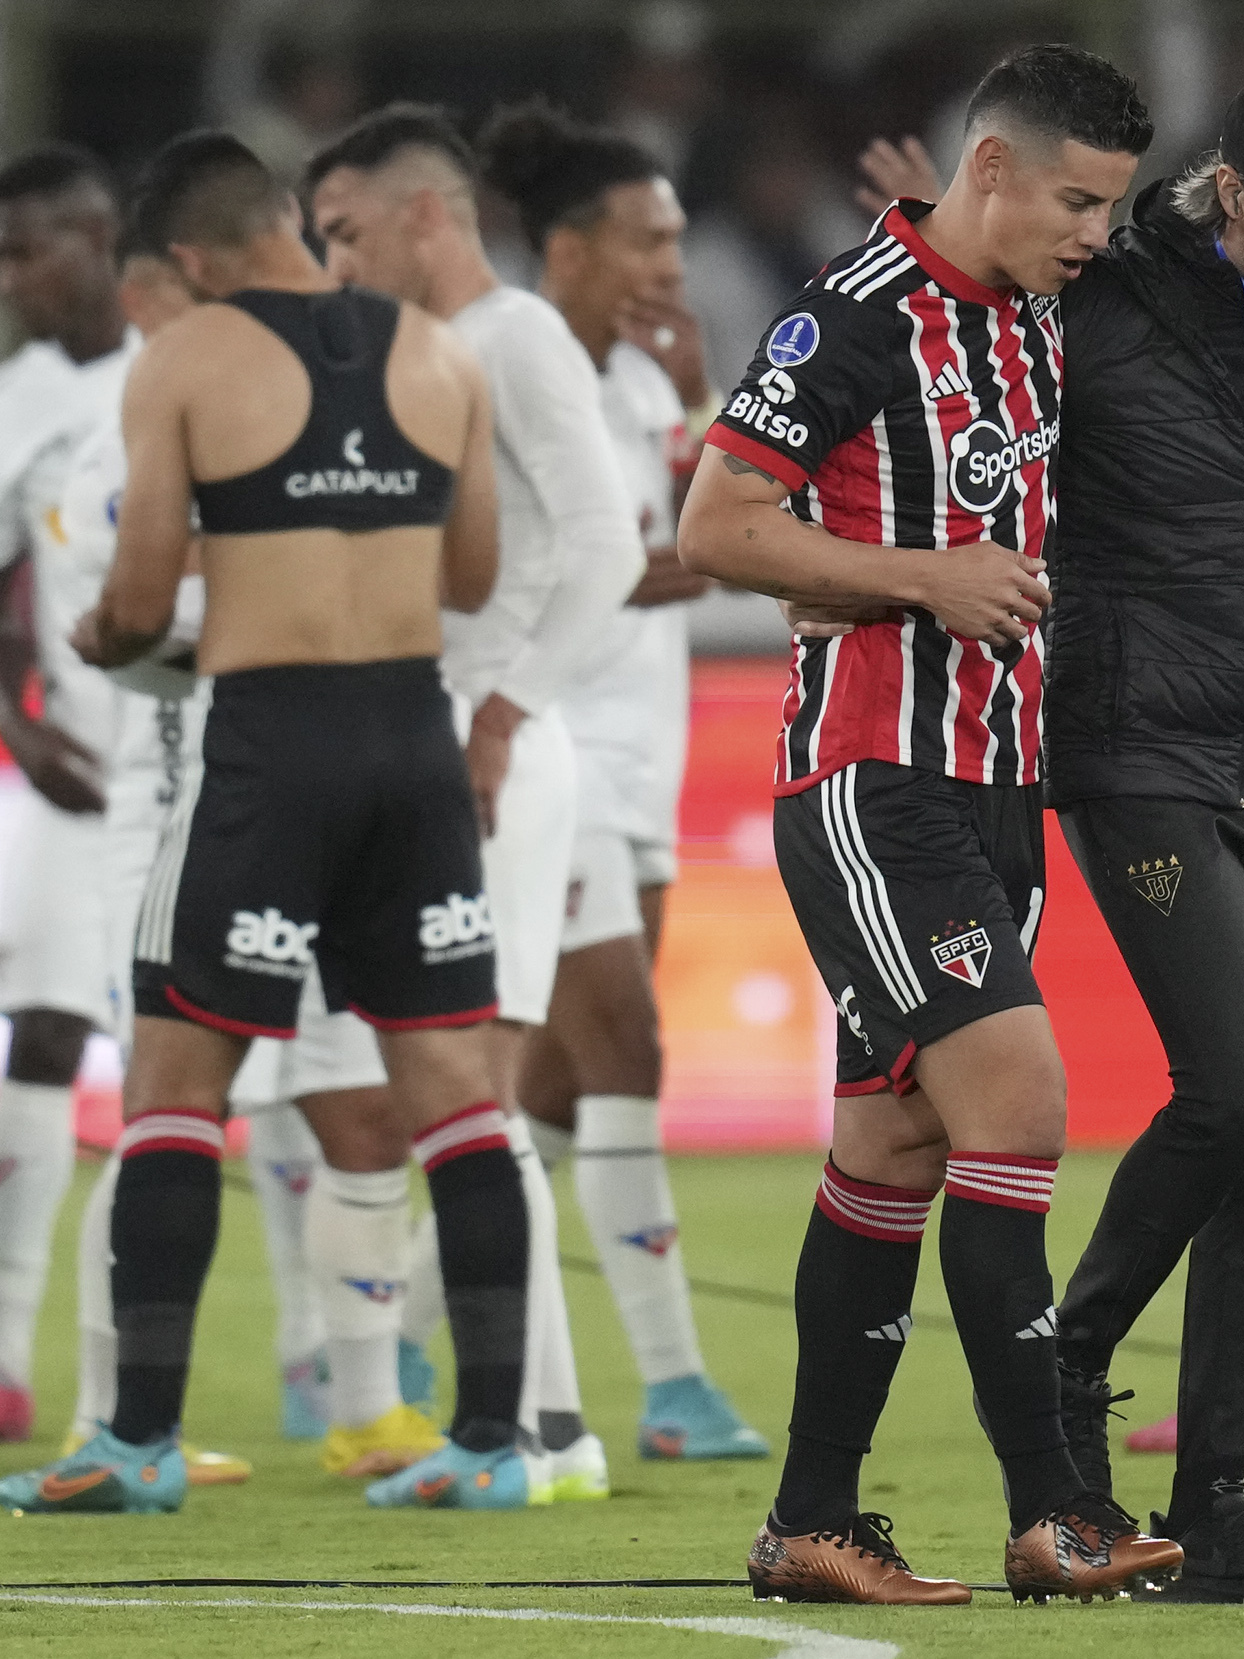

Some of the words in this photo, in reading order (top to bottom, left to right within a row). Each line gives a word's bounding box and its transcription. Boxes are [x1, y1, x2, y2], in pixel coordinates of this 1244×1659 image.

[726, 391, 808, 447] Bitso
[969, 420, 1060, 488] Sportsbe
[285, 467, 420, 498] CATAPULT
[938, 934, 985, 961] SPFC
